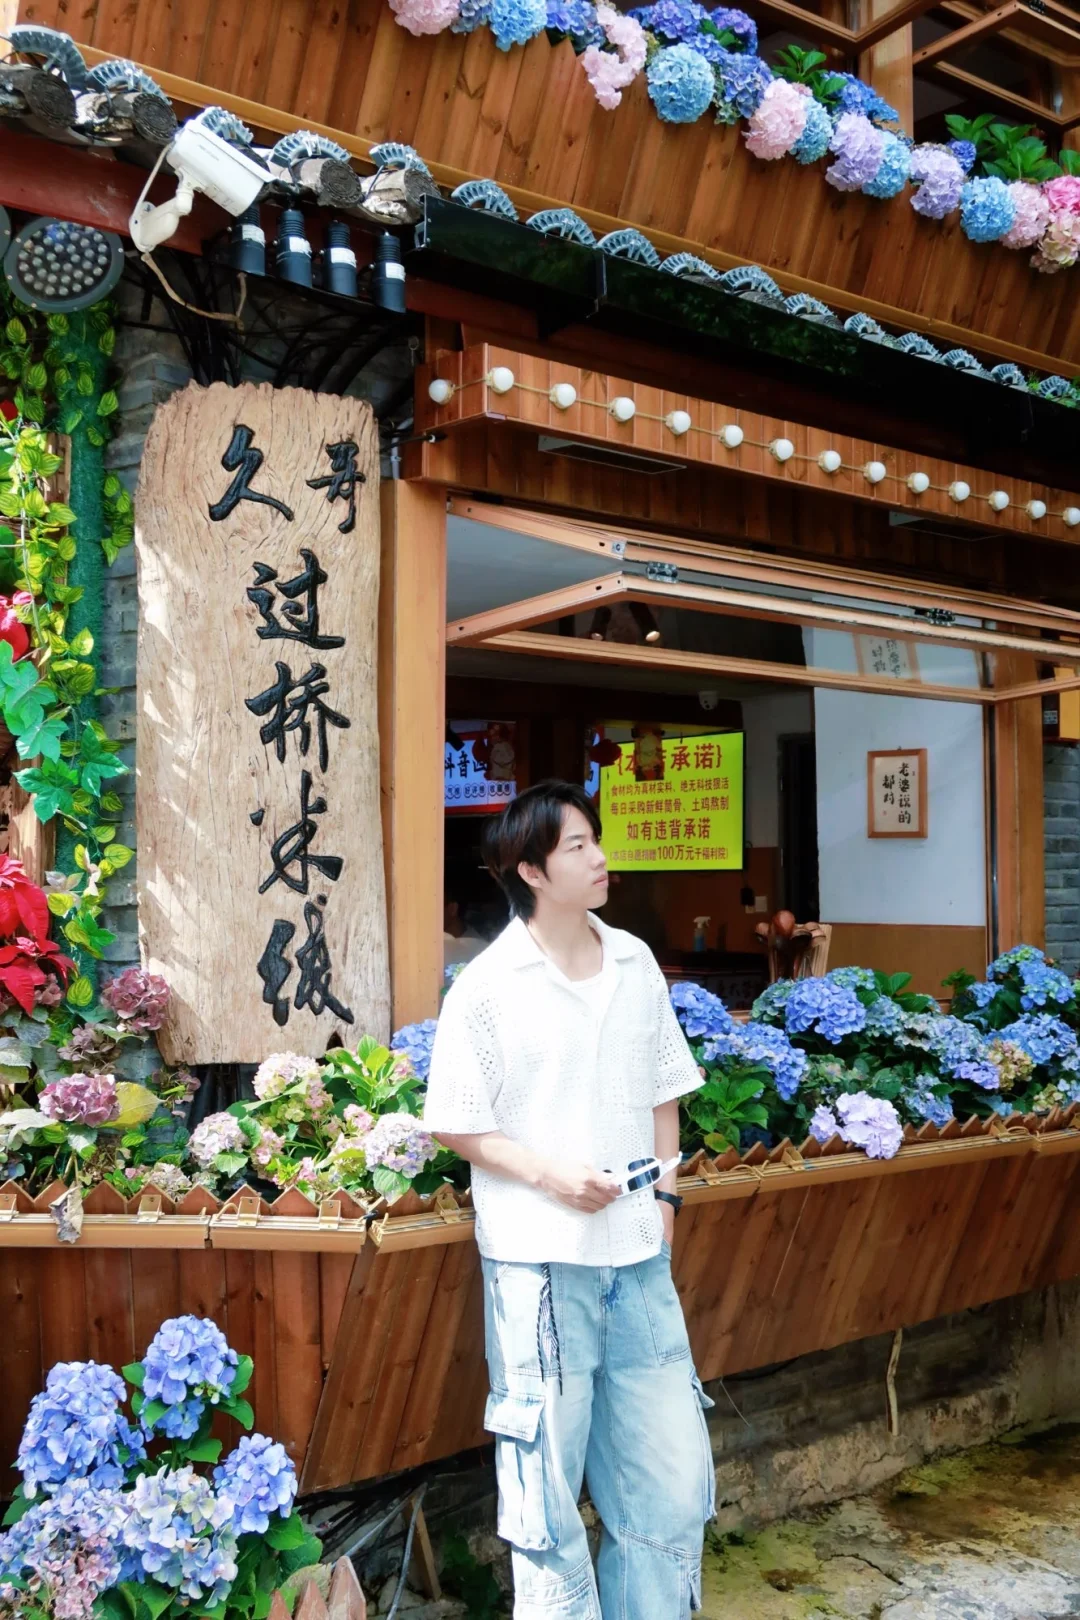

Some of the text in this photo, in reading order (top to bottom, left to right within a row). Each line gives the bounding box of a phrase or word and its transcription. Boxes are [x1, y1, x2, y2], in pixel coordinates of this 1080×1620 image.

[882, 774, 895, 805] 都对
[898, 762, 911, 824] 老婆说的
[626, 817, 711, 841] 如有违背承诺
